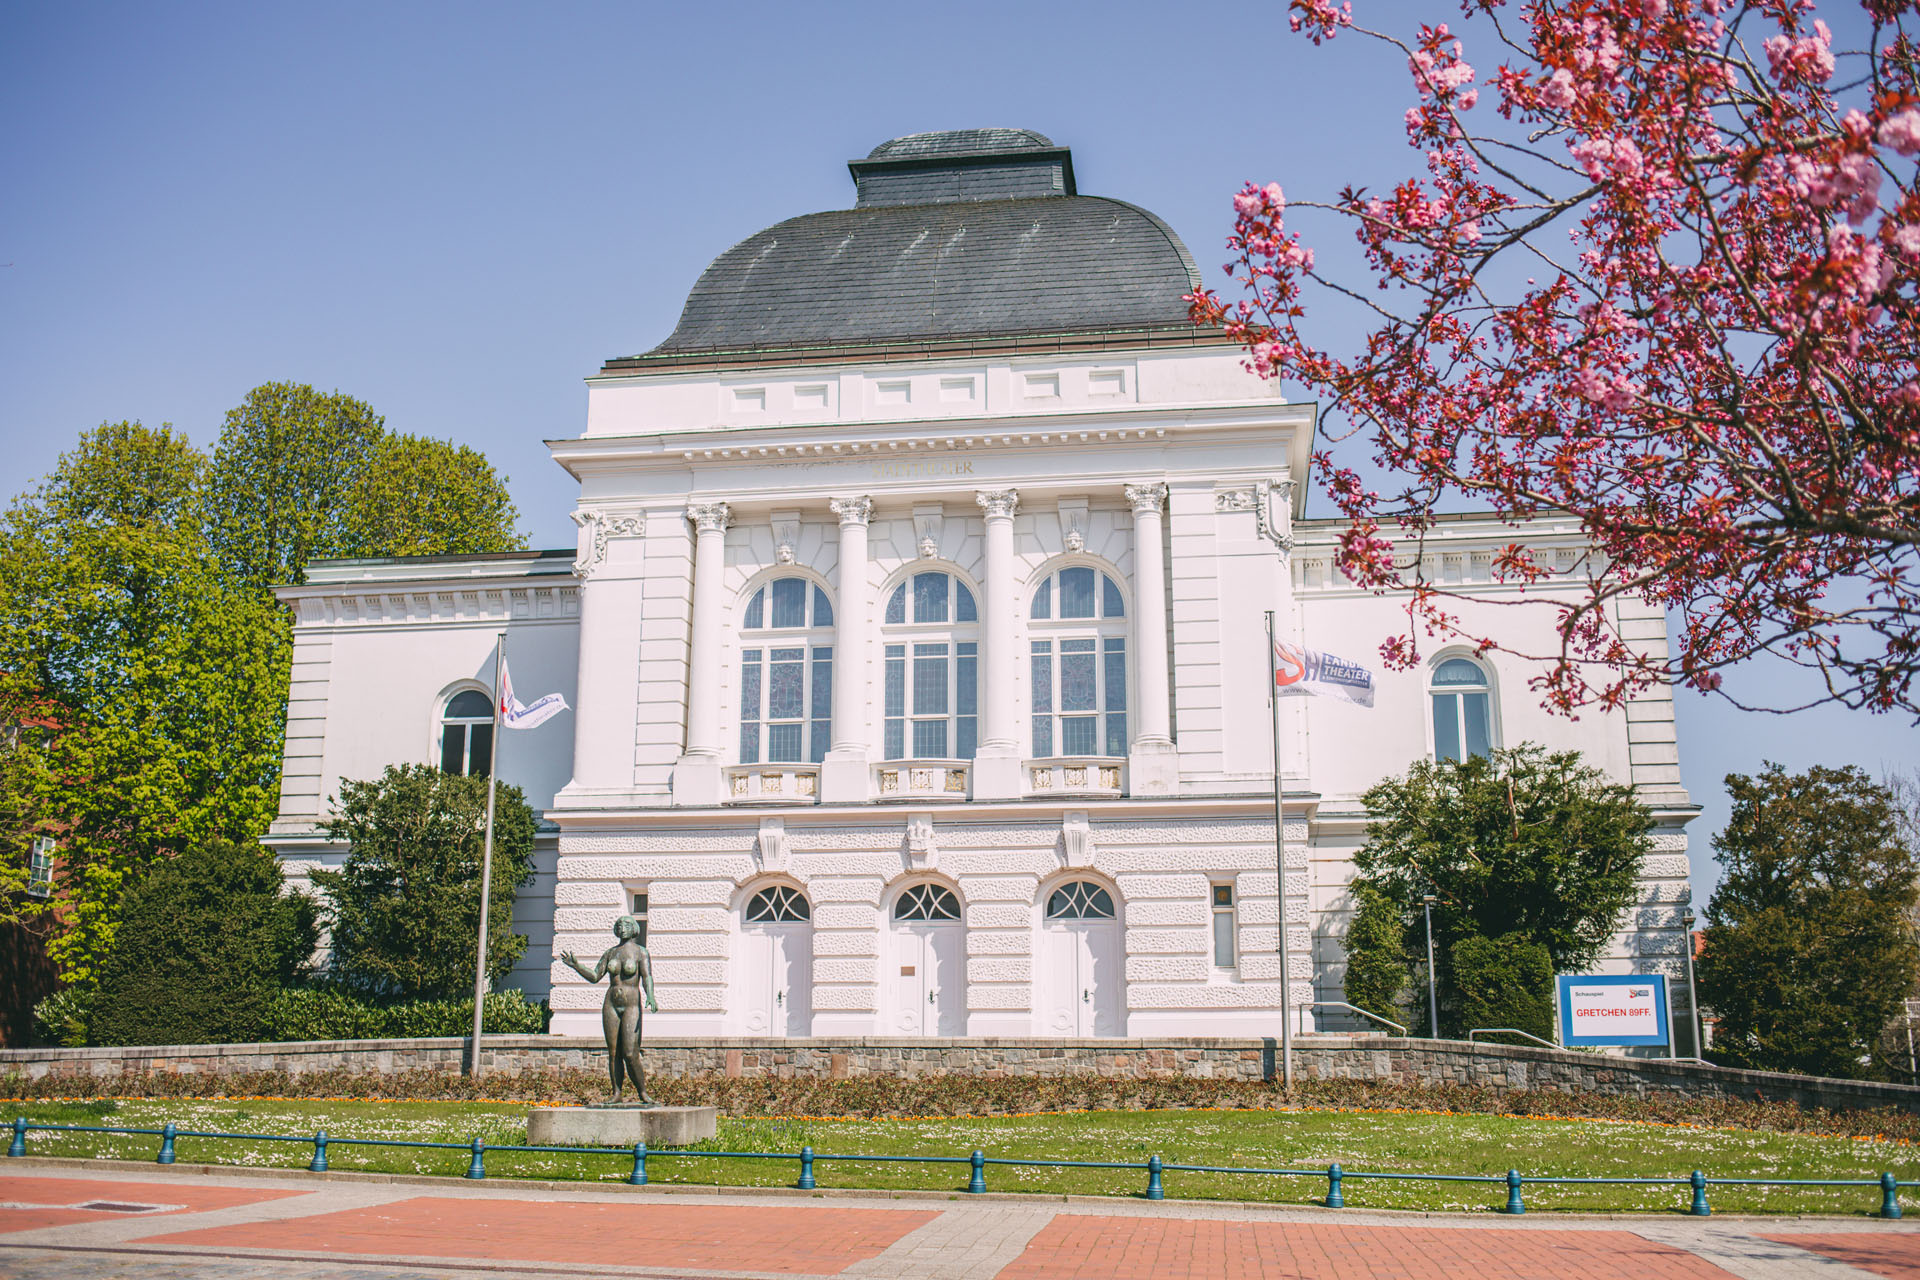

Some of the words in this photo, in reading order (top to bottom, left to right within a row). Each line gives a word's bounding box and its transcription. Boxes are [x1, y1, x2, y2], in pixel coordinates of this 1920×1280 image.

[1324, 665, 1368, 682] THEATER
[1576, 1008, 1627, 1017] GRETCHEN
[1629, 1008, 1651, 1017] 89FF.
